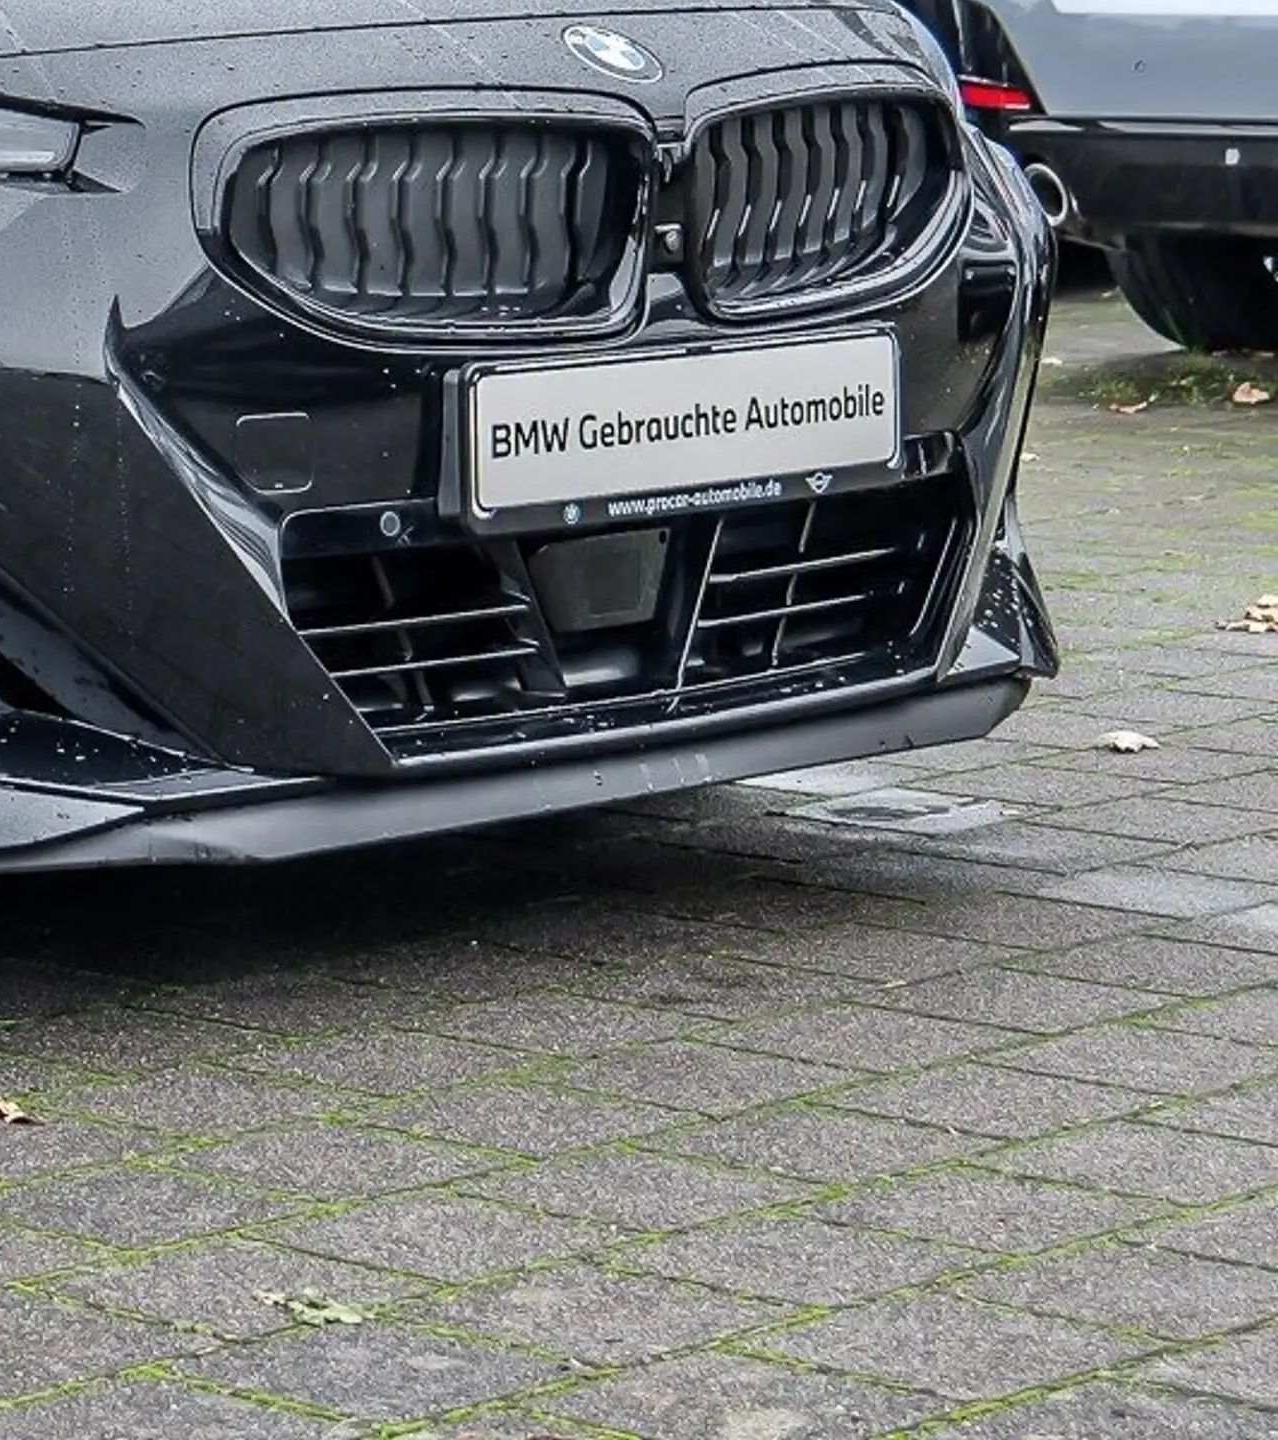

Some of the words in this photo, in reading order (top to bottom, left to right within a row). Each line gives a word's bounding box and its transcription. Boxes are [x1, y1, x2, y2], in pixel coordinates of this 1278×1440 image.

[491, 416, 570, 460] BMW
[578, 402, 738, 450] Gebrauchte
[744, 384, 886, 431] Automobile
